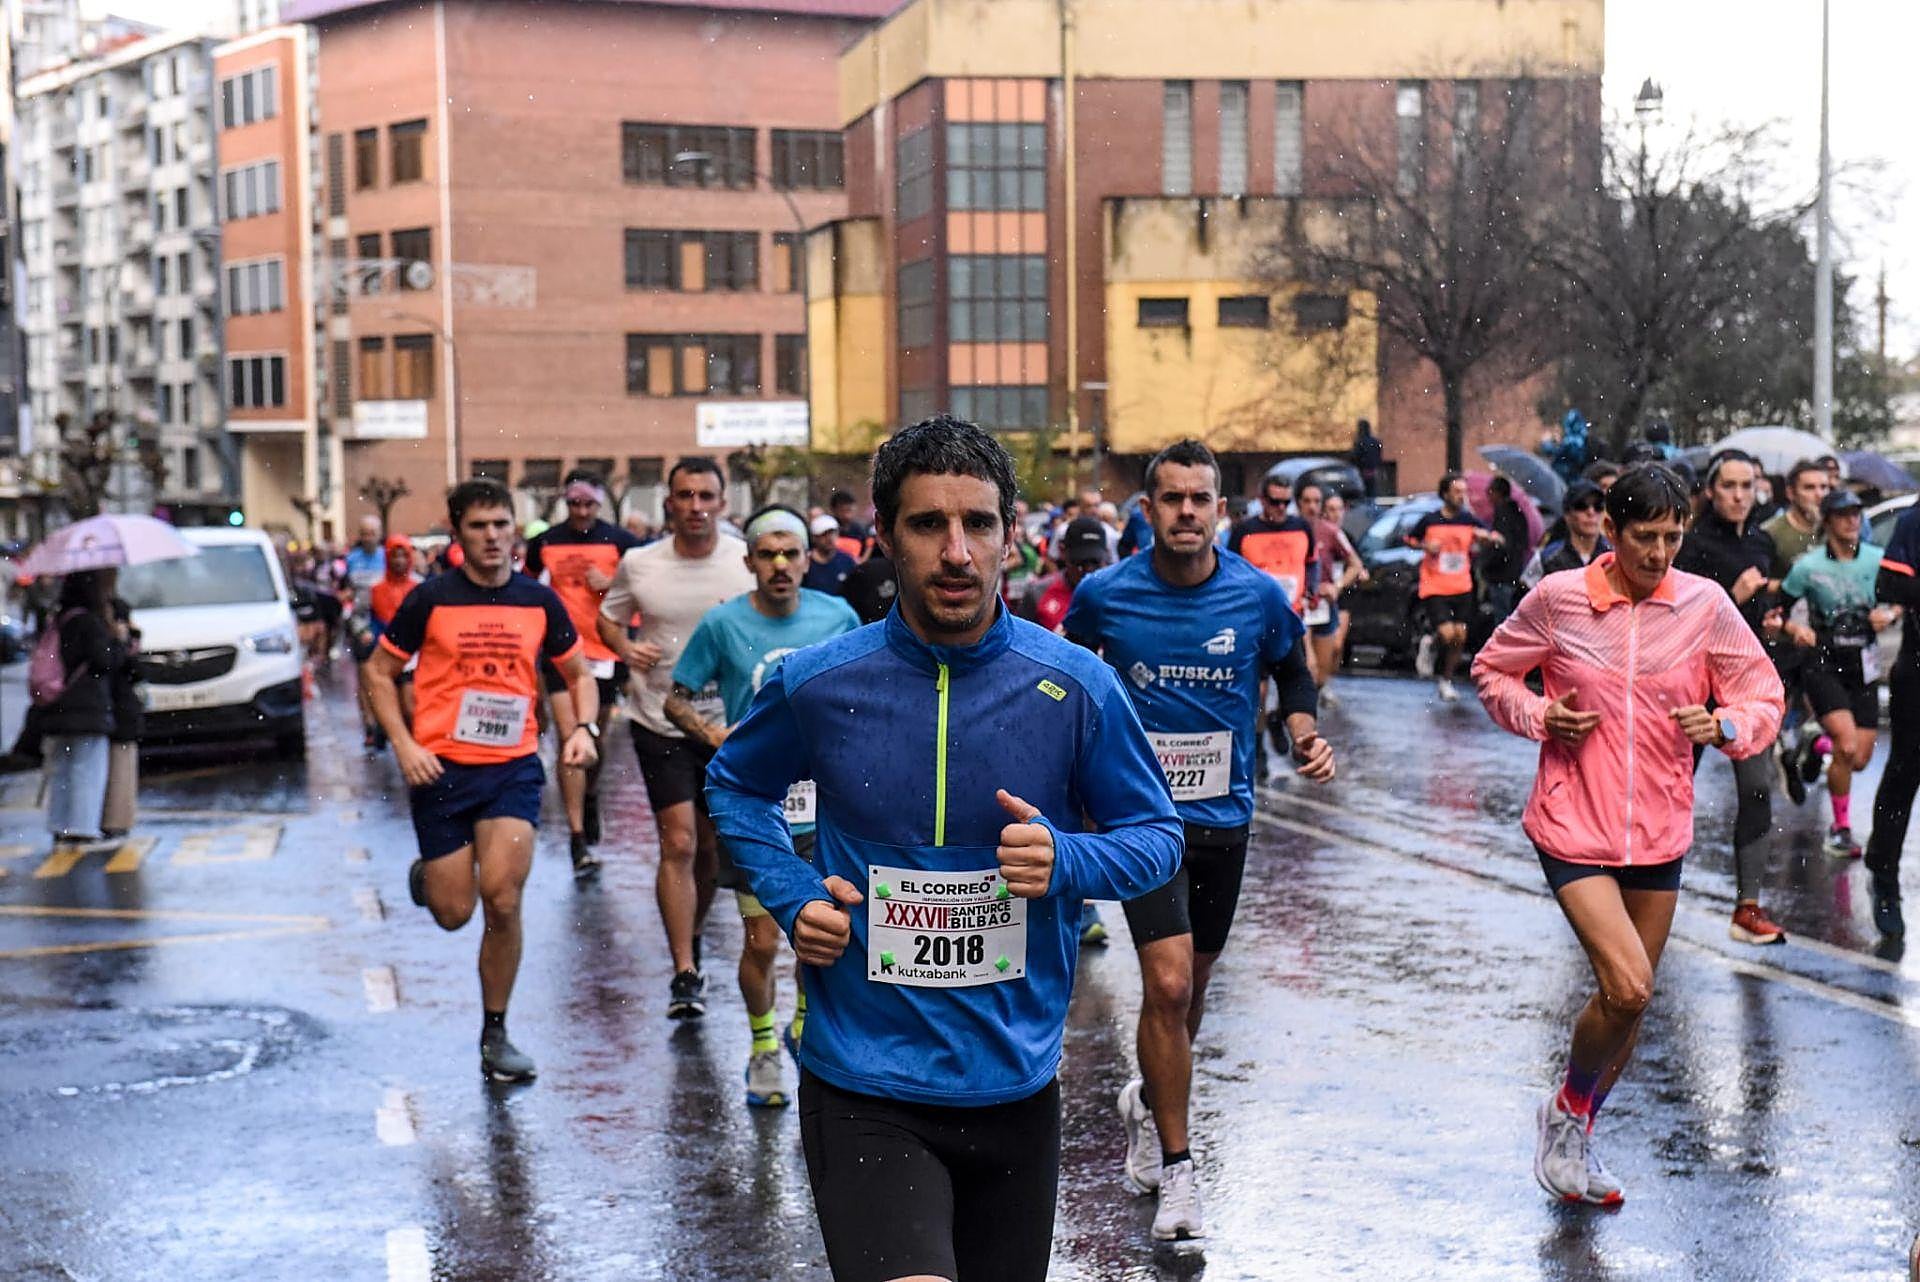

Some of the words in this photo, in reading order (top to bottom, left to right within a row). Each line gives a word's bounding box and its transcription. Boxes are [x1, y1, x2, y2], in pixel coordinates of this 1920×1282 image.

[1158, 665, 1235, 681] EUSKAL
[1169, 739, 1210, 747] CORREO
[1166, 769, 1206, 788] 2227
[901, 881, 919, 893] EL
[922, 881, 991, 896] CORREO
[885, 902, 948, 930] XXXVII
[951, 901, 1012, 917] SANTURCE
[951, 911, 1012, 930] BILBAO
[914, 934, 984, 967] 2018
[898, 966, 967, 980] kutxabank
